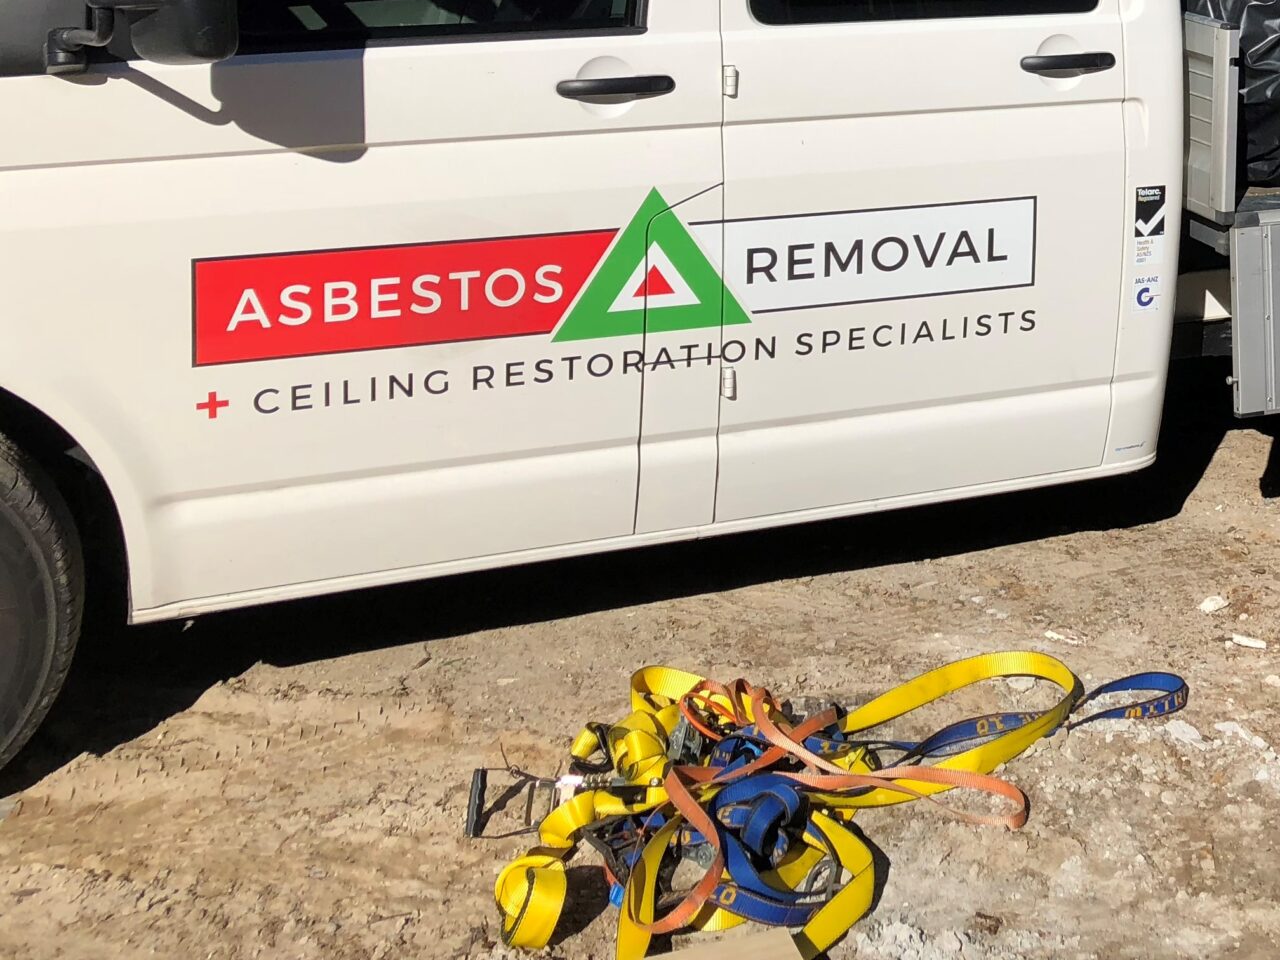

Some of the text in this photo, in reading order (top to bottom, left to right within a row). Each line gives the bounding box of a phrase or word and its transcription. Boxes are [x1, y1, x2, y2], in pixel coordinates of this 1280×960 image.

[225, 227, 1009, 332] ASBESTOS REMOVAL
[1134, 276, 1159, 284] JAS-ANZ
[252, 369, 449, 414] CEILING
[472, 335, 776, 391] RESTORATION
[794, 309, 1038, 356] SPECIALISTS
